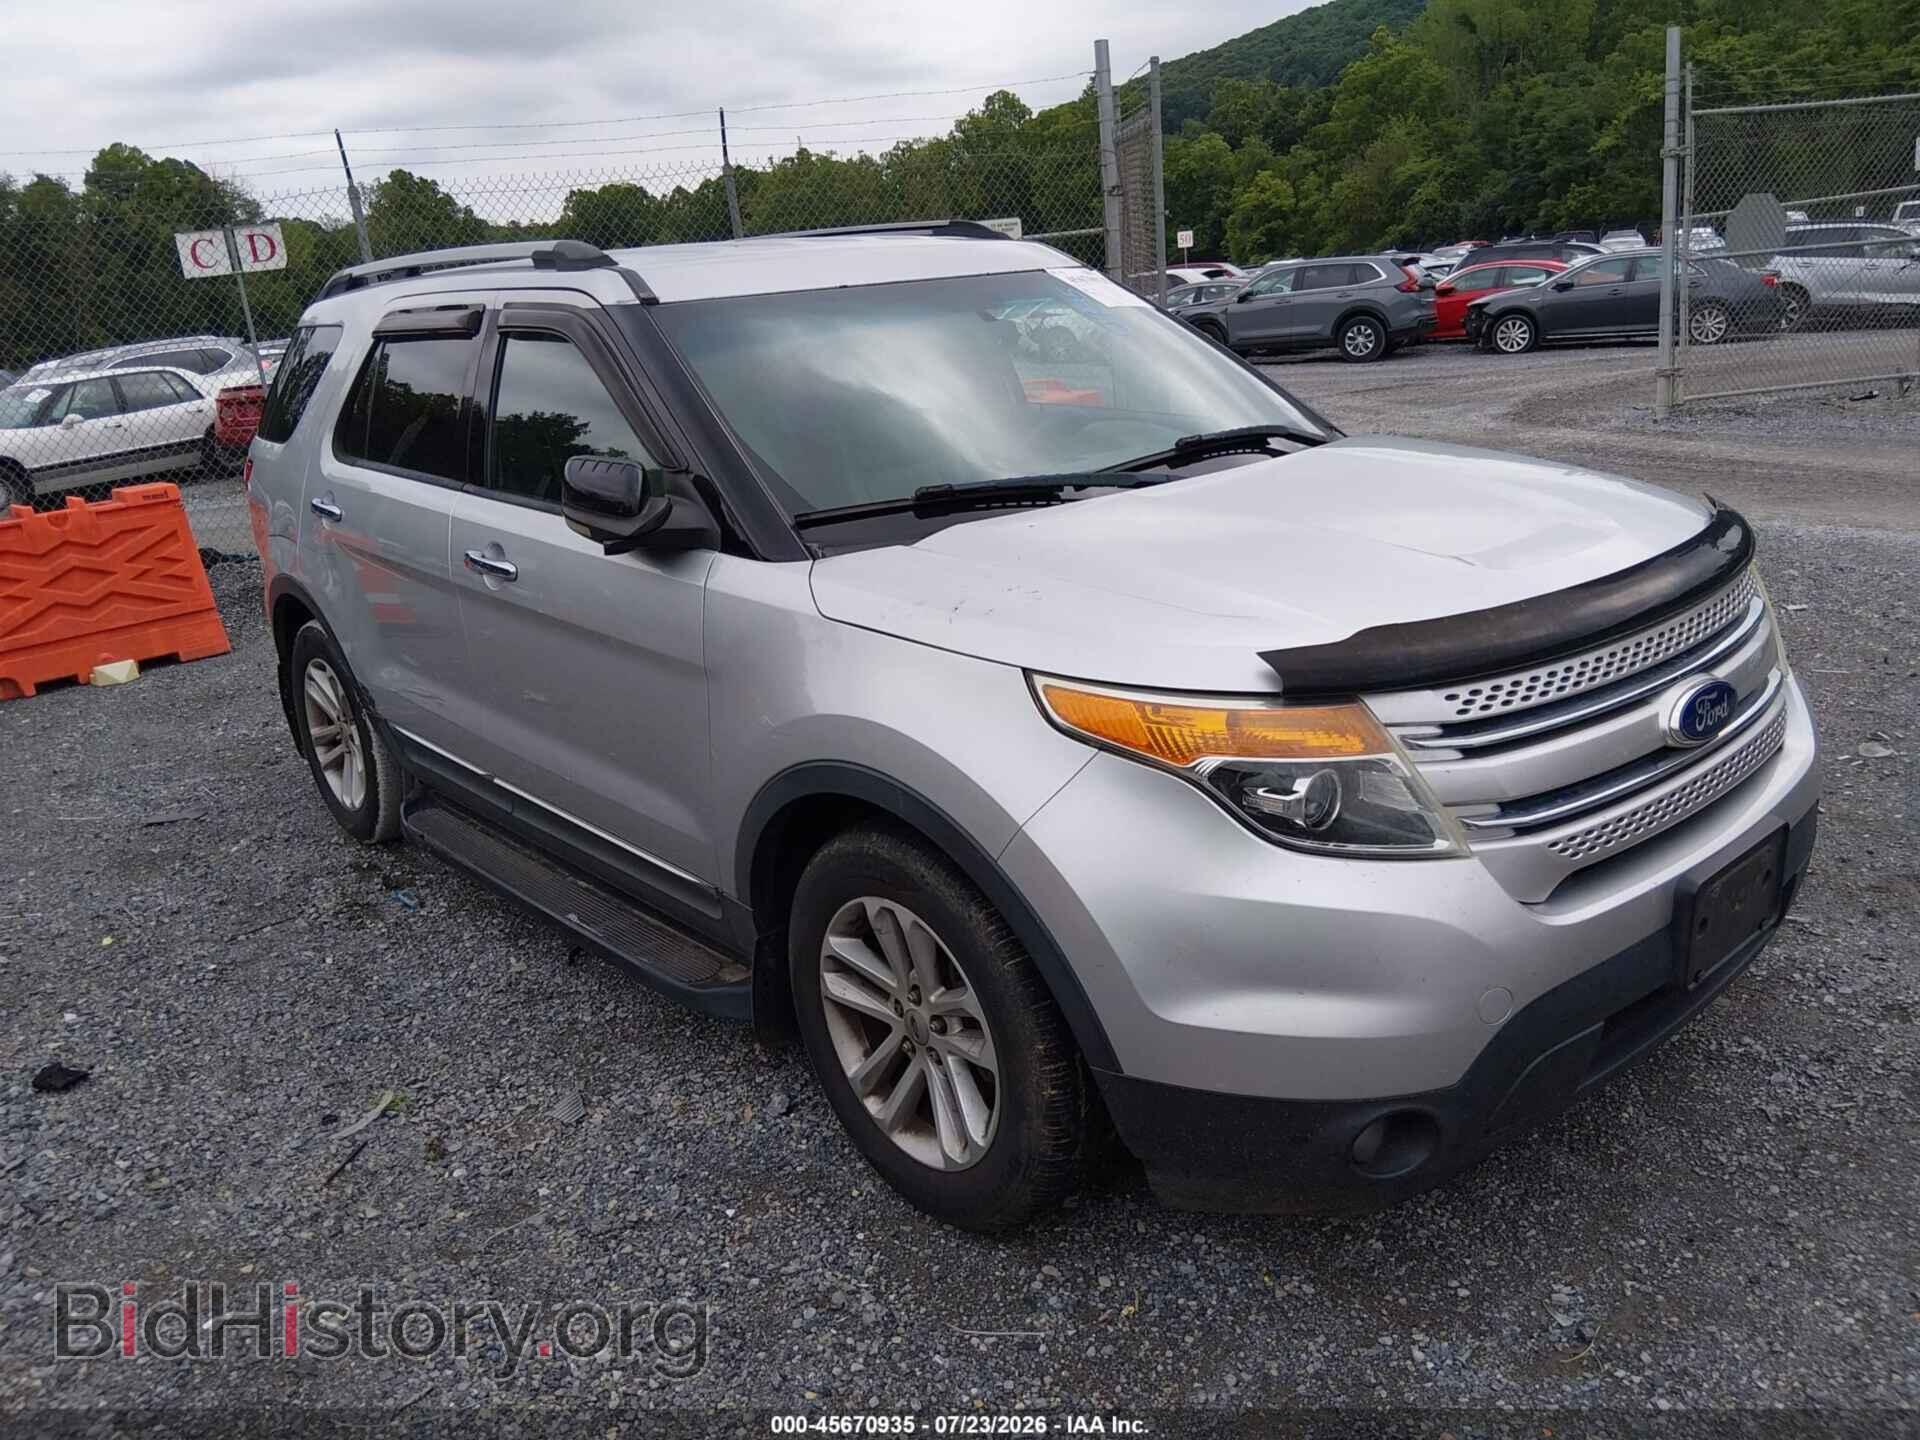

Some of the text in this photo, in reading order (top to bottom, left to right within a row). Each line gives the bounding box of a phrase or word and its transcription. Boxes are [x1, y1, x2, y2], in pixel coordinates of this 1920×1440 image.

[190, 239, 218, 269] C
[245, 233, 276, 263] D
[1695, 690, 1728, 731] Ford
